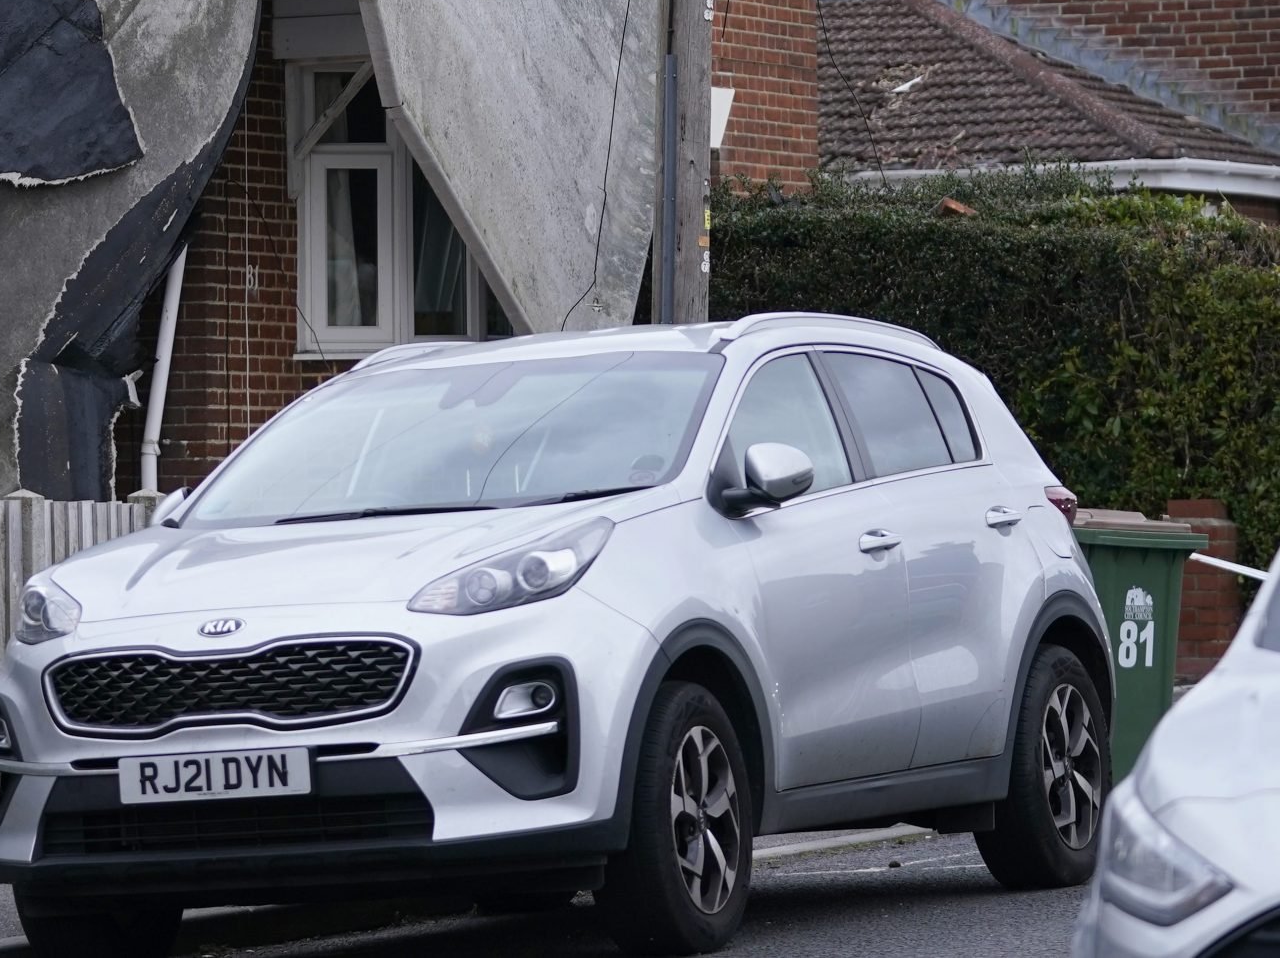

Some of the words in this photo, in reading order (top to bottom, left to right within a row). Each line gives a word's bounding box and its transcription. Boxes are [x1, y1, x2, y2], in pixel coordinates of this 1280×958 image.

[203, 619, 236, 634] KIA
[1124, 612, 1135, 620] CITY
[1117, 620, 1155, 668] 81
[139, 757, 213, 795] RJ21
[222, 753, 289, 790] DYN
